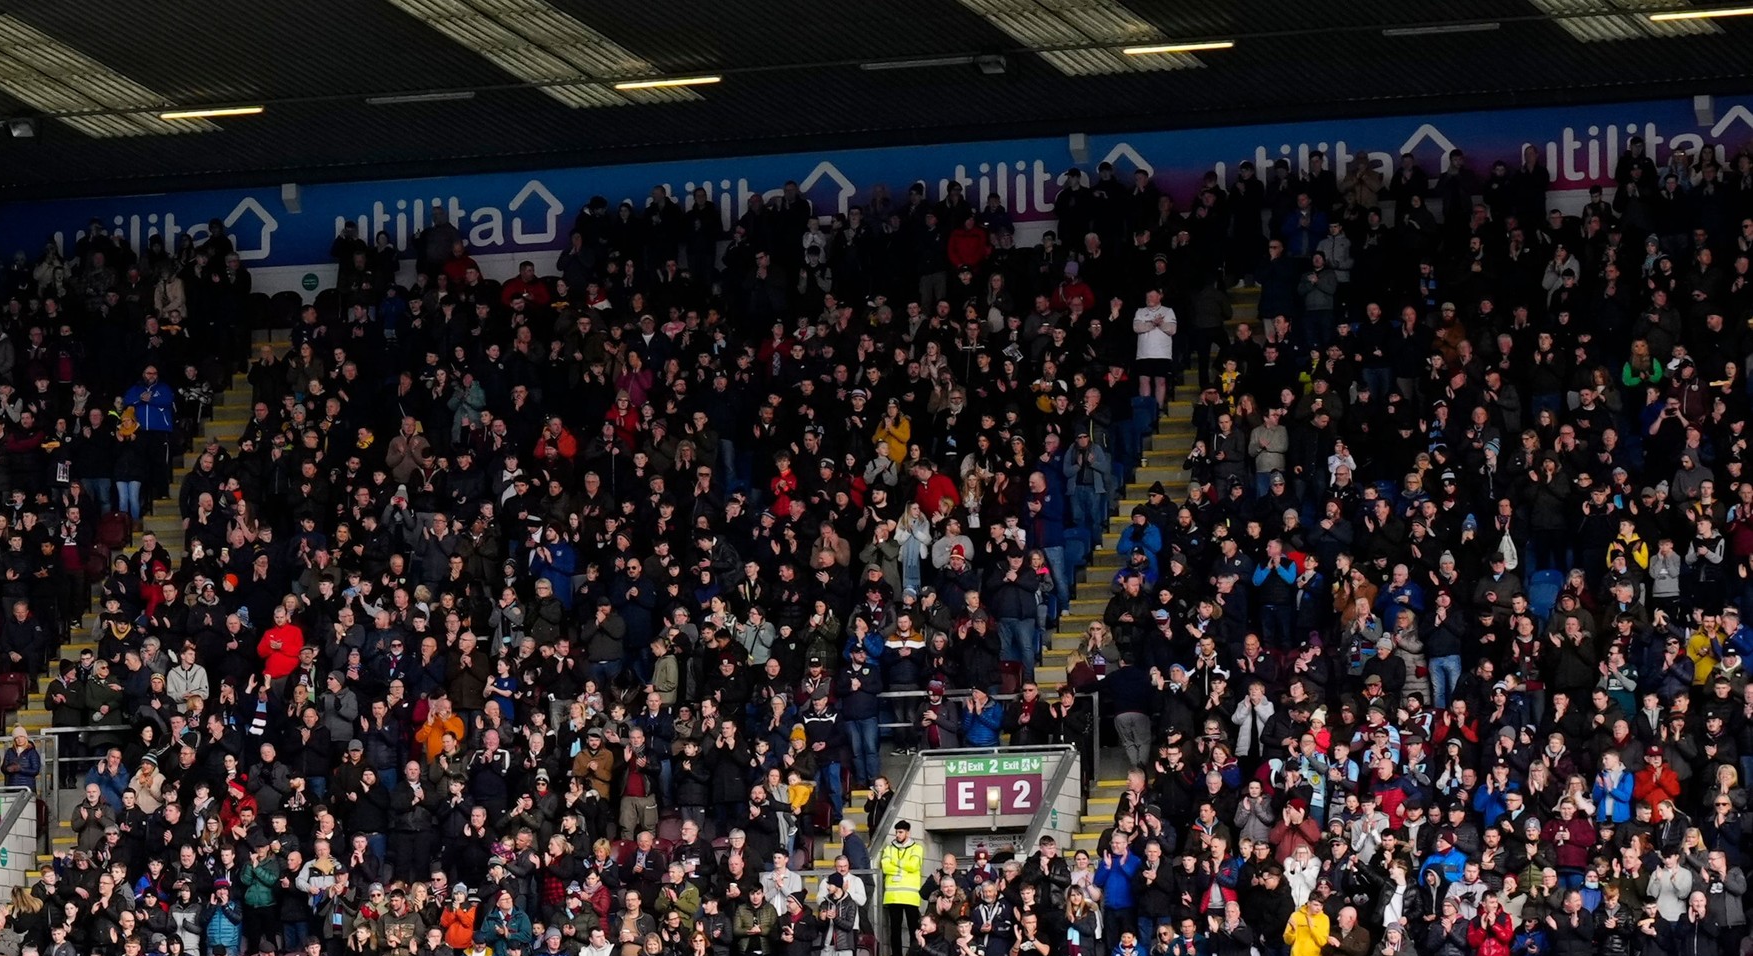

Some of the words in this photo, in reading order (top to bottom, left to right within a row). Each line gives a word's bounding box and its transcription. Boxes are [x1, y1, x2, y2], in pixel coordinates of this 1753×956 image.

[334, 195, 505, 253] utilta
[967, 762, 984, 772] Exit
[989, 759, 999, 773] 2
[1003, 761, 1020, 770] Exit
[957, 781, 975, 810] E
[1012, 780, 1031, 808] 2
